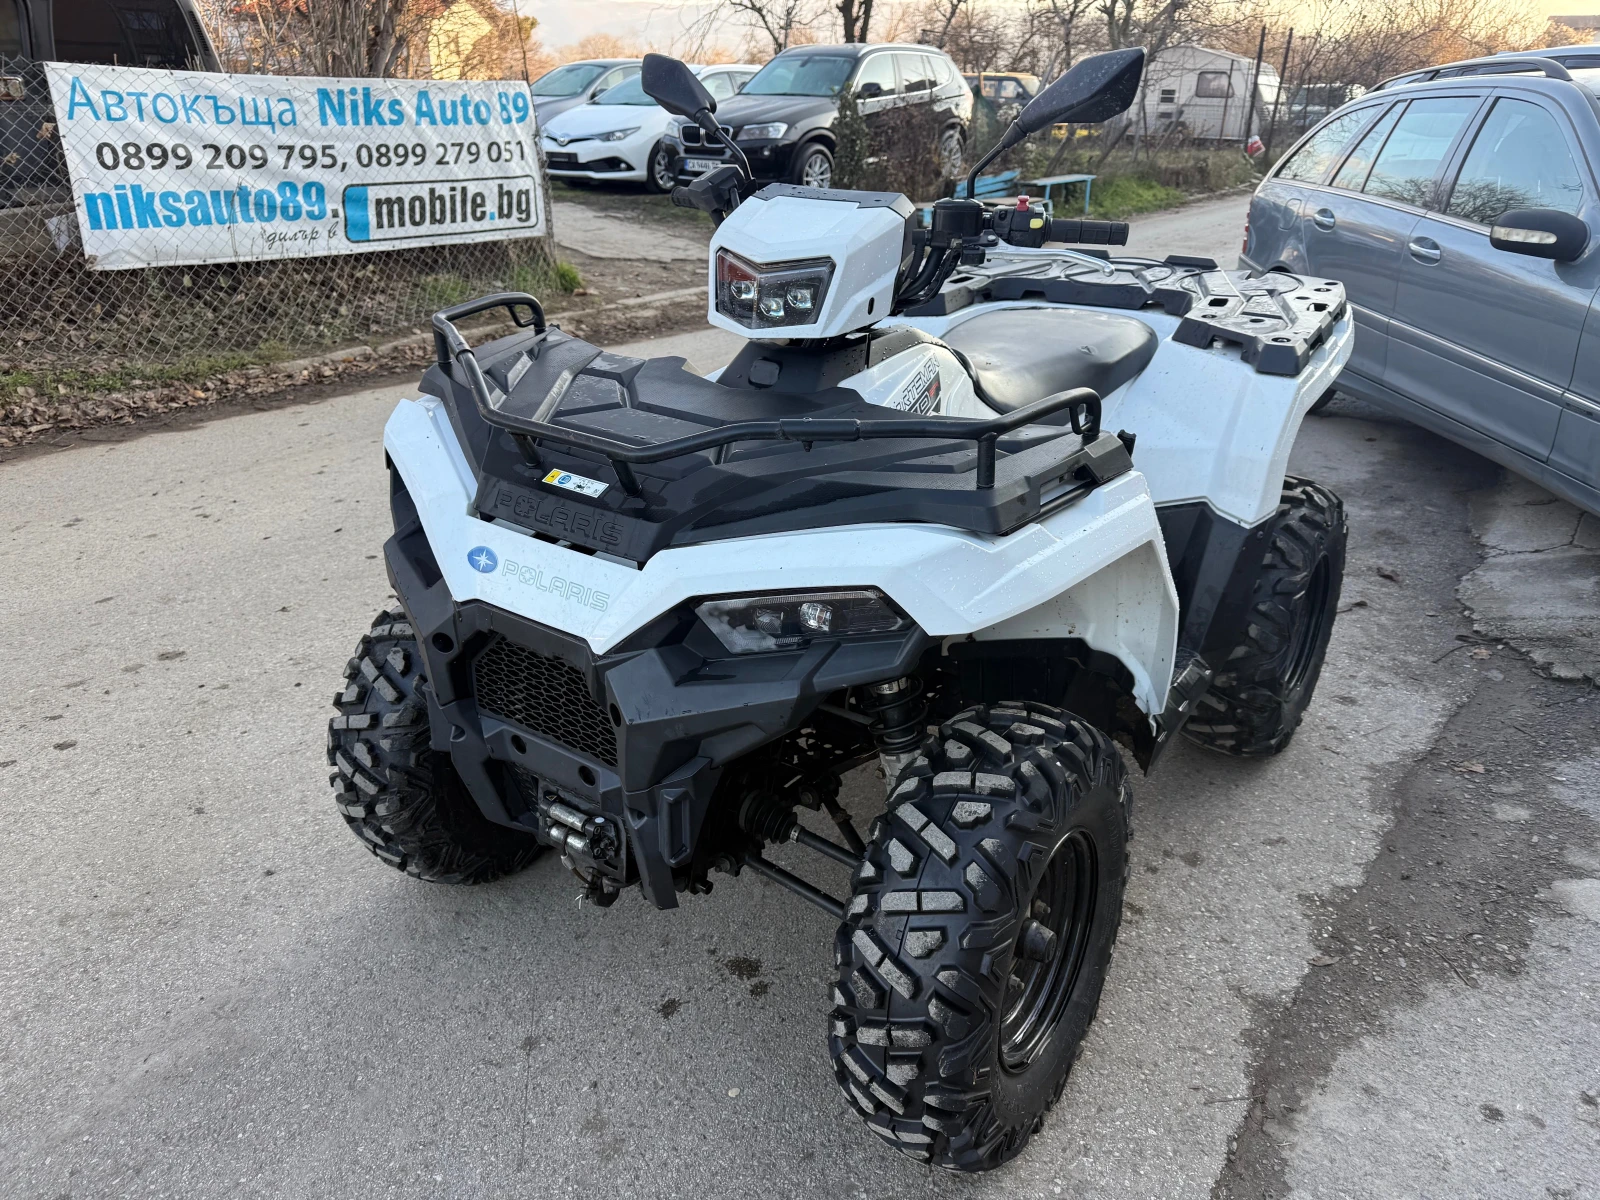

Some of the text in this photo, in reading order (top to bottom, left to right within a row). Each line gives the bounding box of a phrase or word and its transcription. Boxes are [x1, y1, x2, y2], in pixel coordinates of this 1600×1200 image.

[67, 76, 298, 134] Автокъща
[316, 87, 529, 126] Niks Auto 89
[95, 140, 525, 172] 0899 209 795, 0899 279 051
[375, 183, 531, 230] mobile.bg
[494, 488, 625, 547] POLARIS
[501, 559, 611, 613] POLARIS
